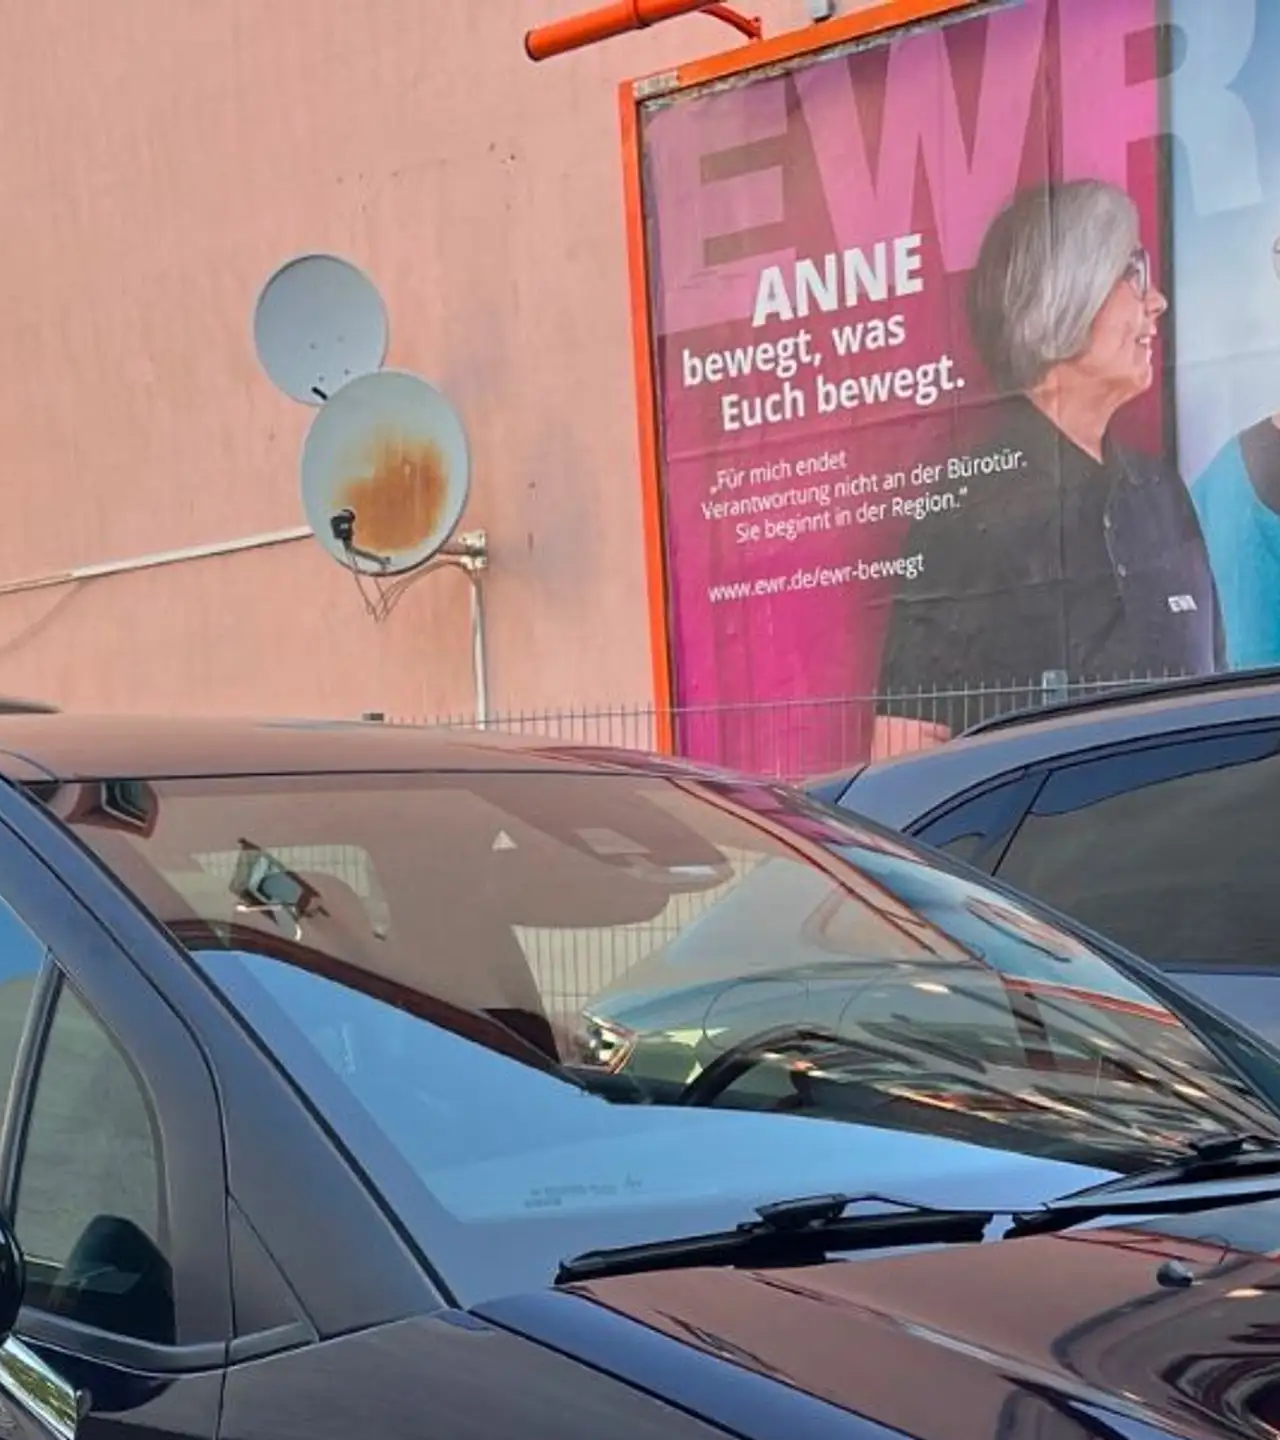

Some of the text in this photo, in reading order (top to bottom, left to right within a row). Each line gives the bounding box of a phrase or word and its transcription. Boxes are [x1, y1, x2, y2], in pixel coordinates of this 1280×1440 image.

[752, 233, 924, 327] ANNE
[682, 314, 906, 388] bewegt, was
[721, 354, 965, 431] Euch bewegt.
[701, 448, 1027, 520] Verantwortung nicht an der Bürotür.
[750, 459, 792, 485] mich
[796, 450, 846, 476] endet
[736, 522, 760, 544] Sie
[765, 510, 831, 541] beginnt
[835, 506, 852, 527] in
[856, 501, 886, 524] der
[707, 552, 925, 603] www.ewr.de/ewr-bewegt
